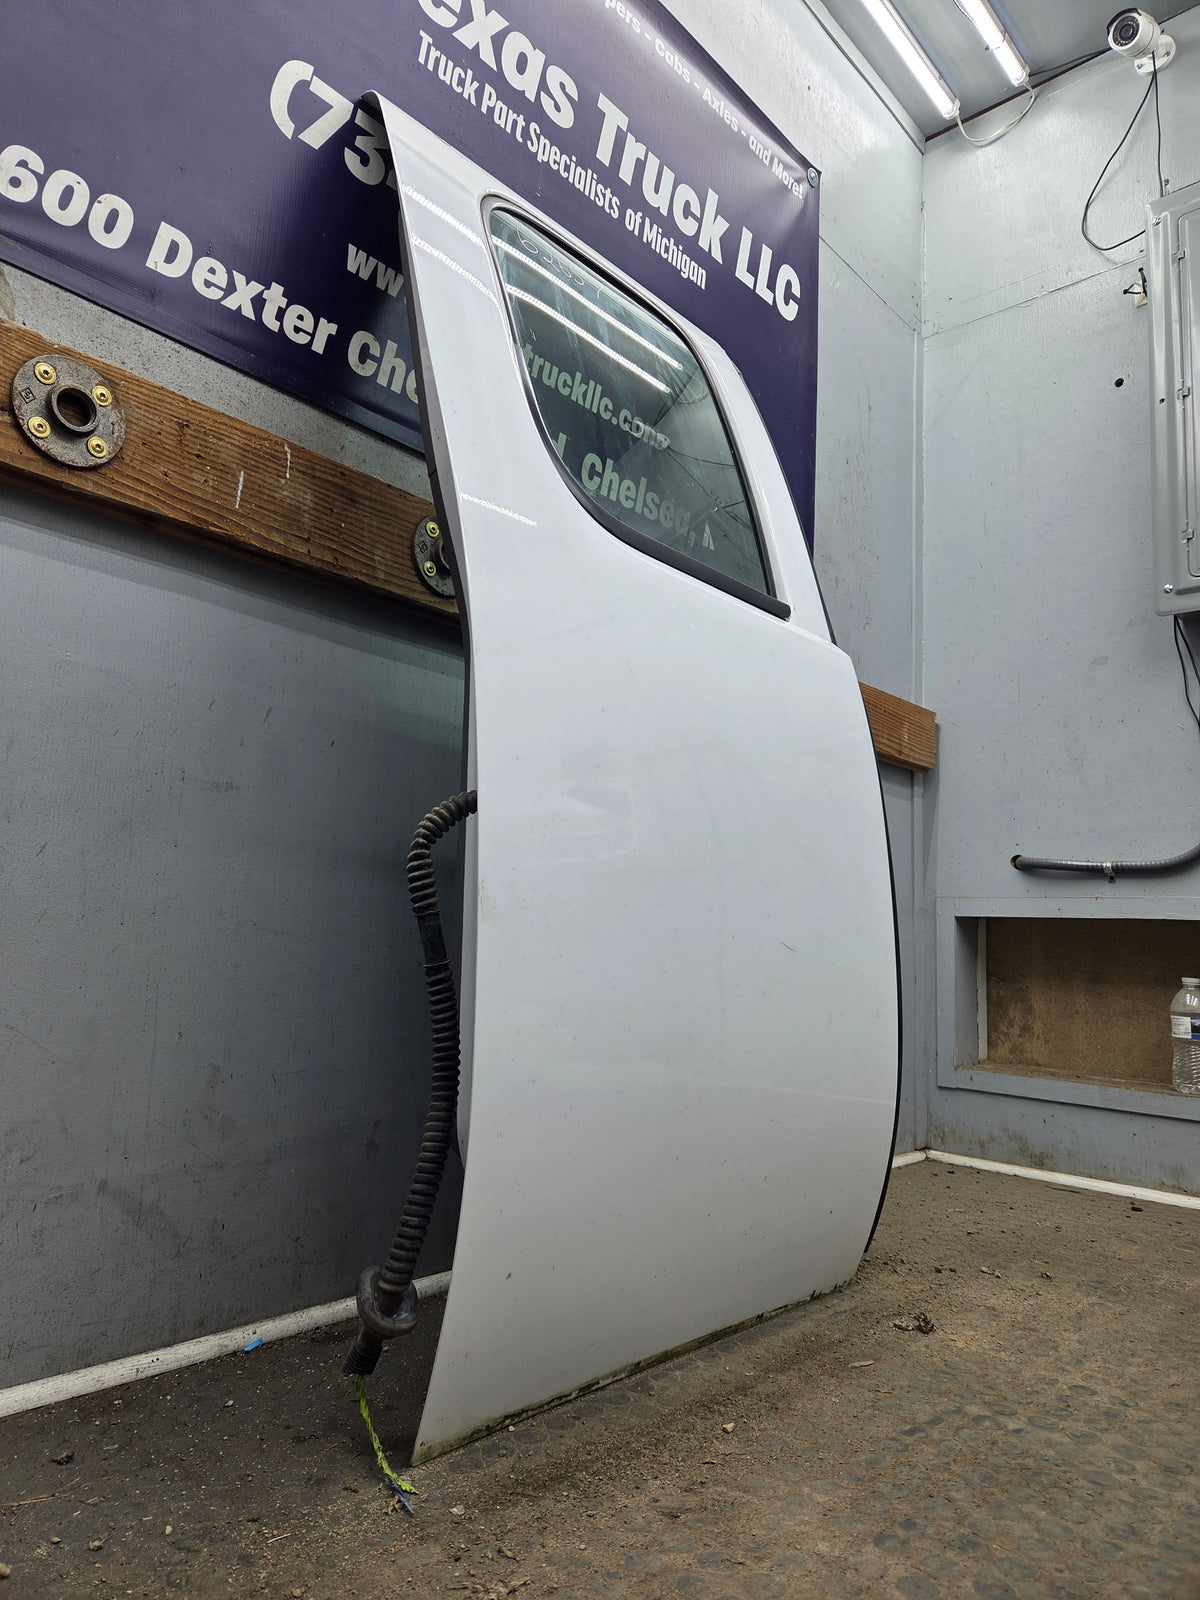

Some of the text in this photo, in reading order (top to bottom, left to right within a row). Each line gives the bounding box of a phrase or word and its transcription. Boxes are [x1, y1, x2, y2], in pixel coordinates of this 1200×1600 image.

[269, 59, 398, 191] (73
[417, 29, 707, 290] Truck Part Specialists of Michigan
[596, 91, 730, 265] Truck
[735, 225, 801, 321] LLC
[655, 38, 691, 84] Cabs
[702, 87, 739, 132] Axles
[749, 135, 771, 167] and
[772, 155, 804, 199] More!
[0, 144, 135, 250] 600
[145, 221, 338, 356] Dexter
[581, 452, 697, 548] Chelsea,
